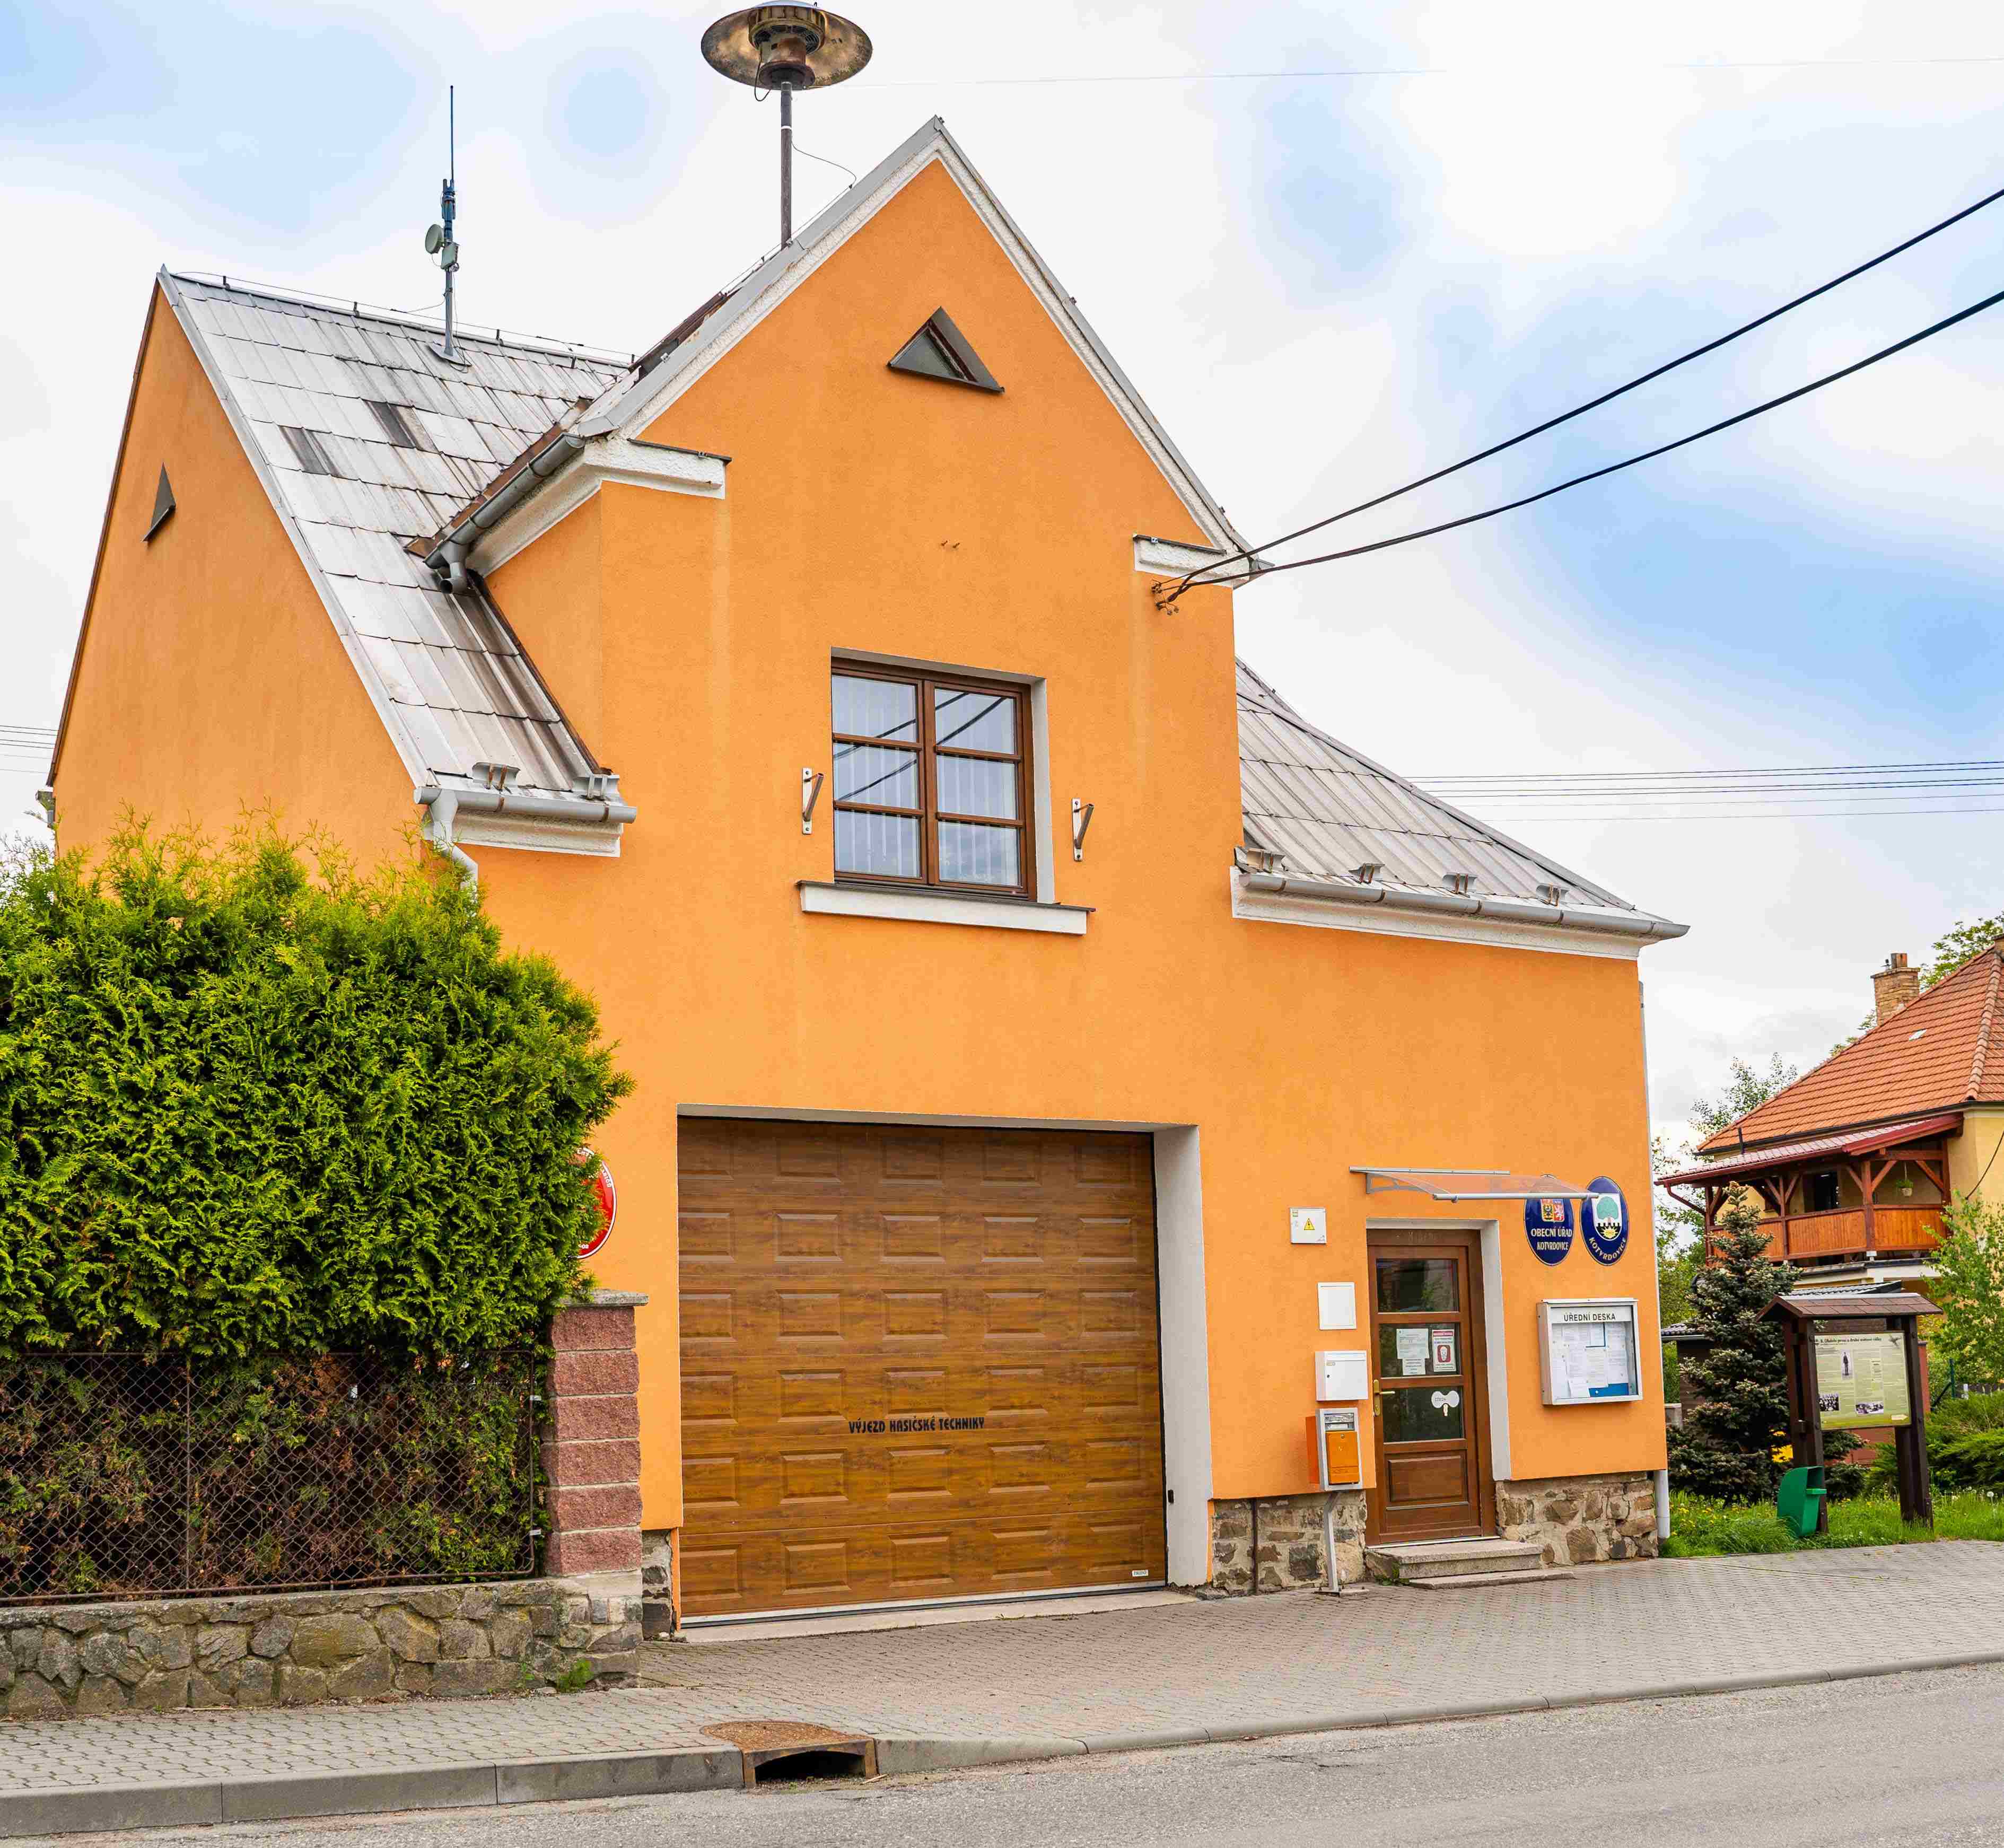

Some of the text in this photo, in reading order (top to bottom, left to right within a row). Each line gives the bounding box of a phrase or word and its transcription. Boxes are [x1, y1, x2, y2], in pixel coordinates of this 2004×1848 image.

[1530, 1225, 1572, 1237] OBECNÍ ÚŘAD
[1537, 1241, 1569, 1251] KOTVRDOVICE
[1589, 1237, 1626, 1260] KOTVRDOVICE
[1564, 1312, 1591, 1321] ÚŘEDNÍ
[848, 1415, 985, 1434] VÝJEZD HASIČSKÉ TECHNIKY
